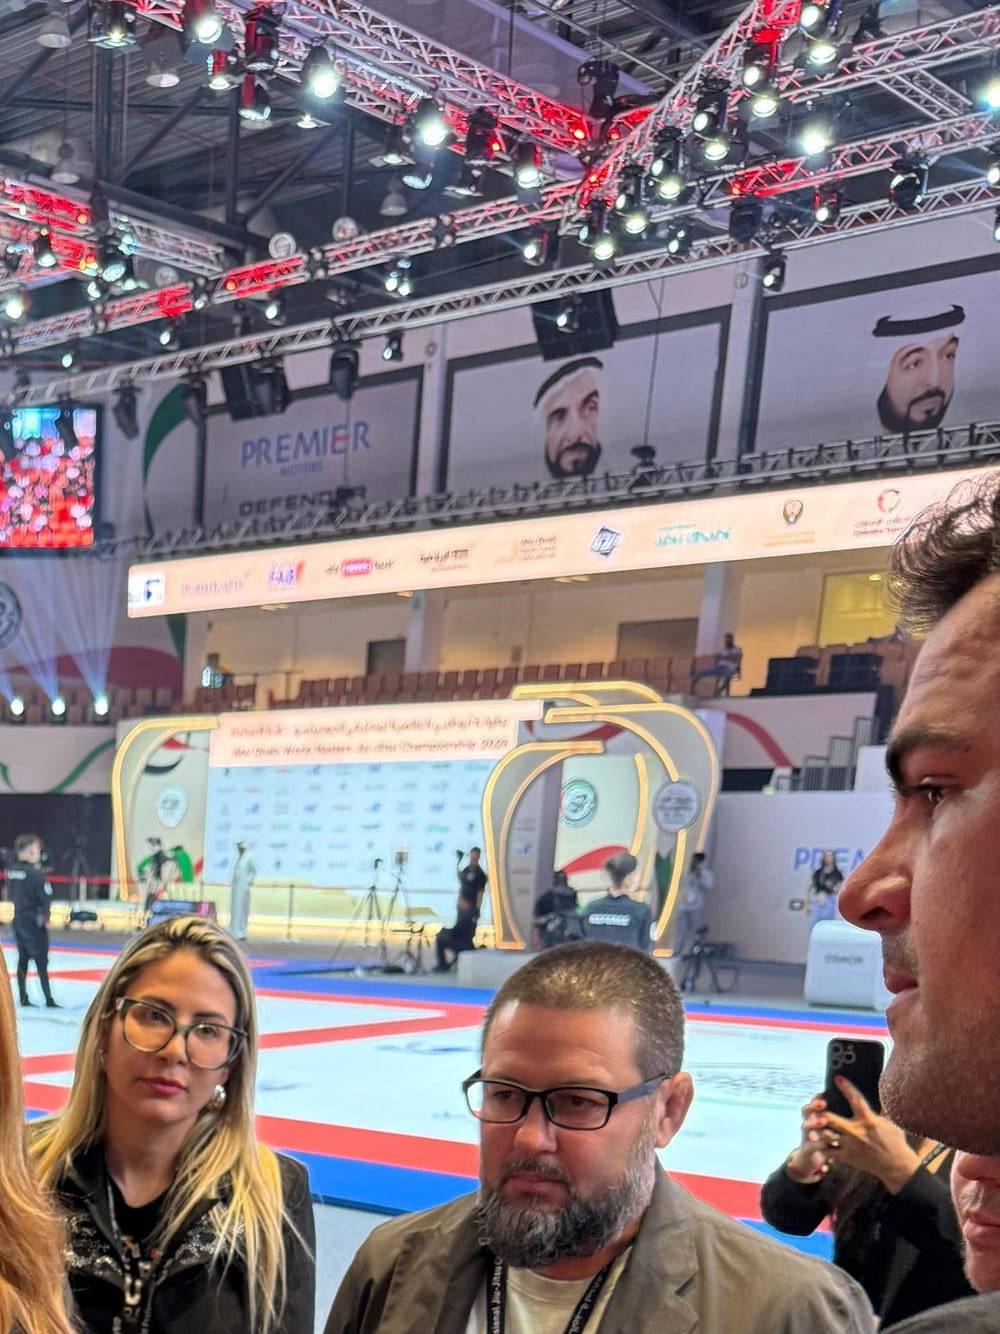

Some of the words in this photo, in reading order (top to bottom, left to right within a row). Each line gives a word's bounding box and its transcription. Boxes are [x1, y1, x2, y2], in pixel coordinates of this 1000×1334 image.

[241, 421, 371, 469] PREMIER
[239, 485, 366, 516] DEFENDR
[490, 1266, 502, 1304] Jiu-Jitsu
